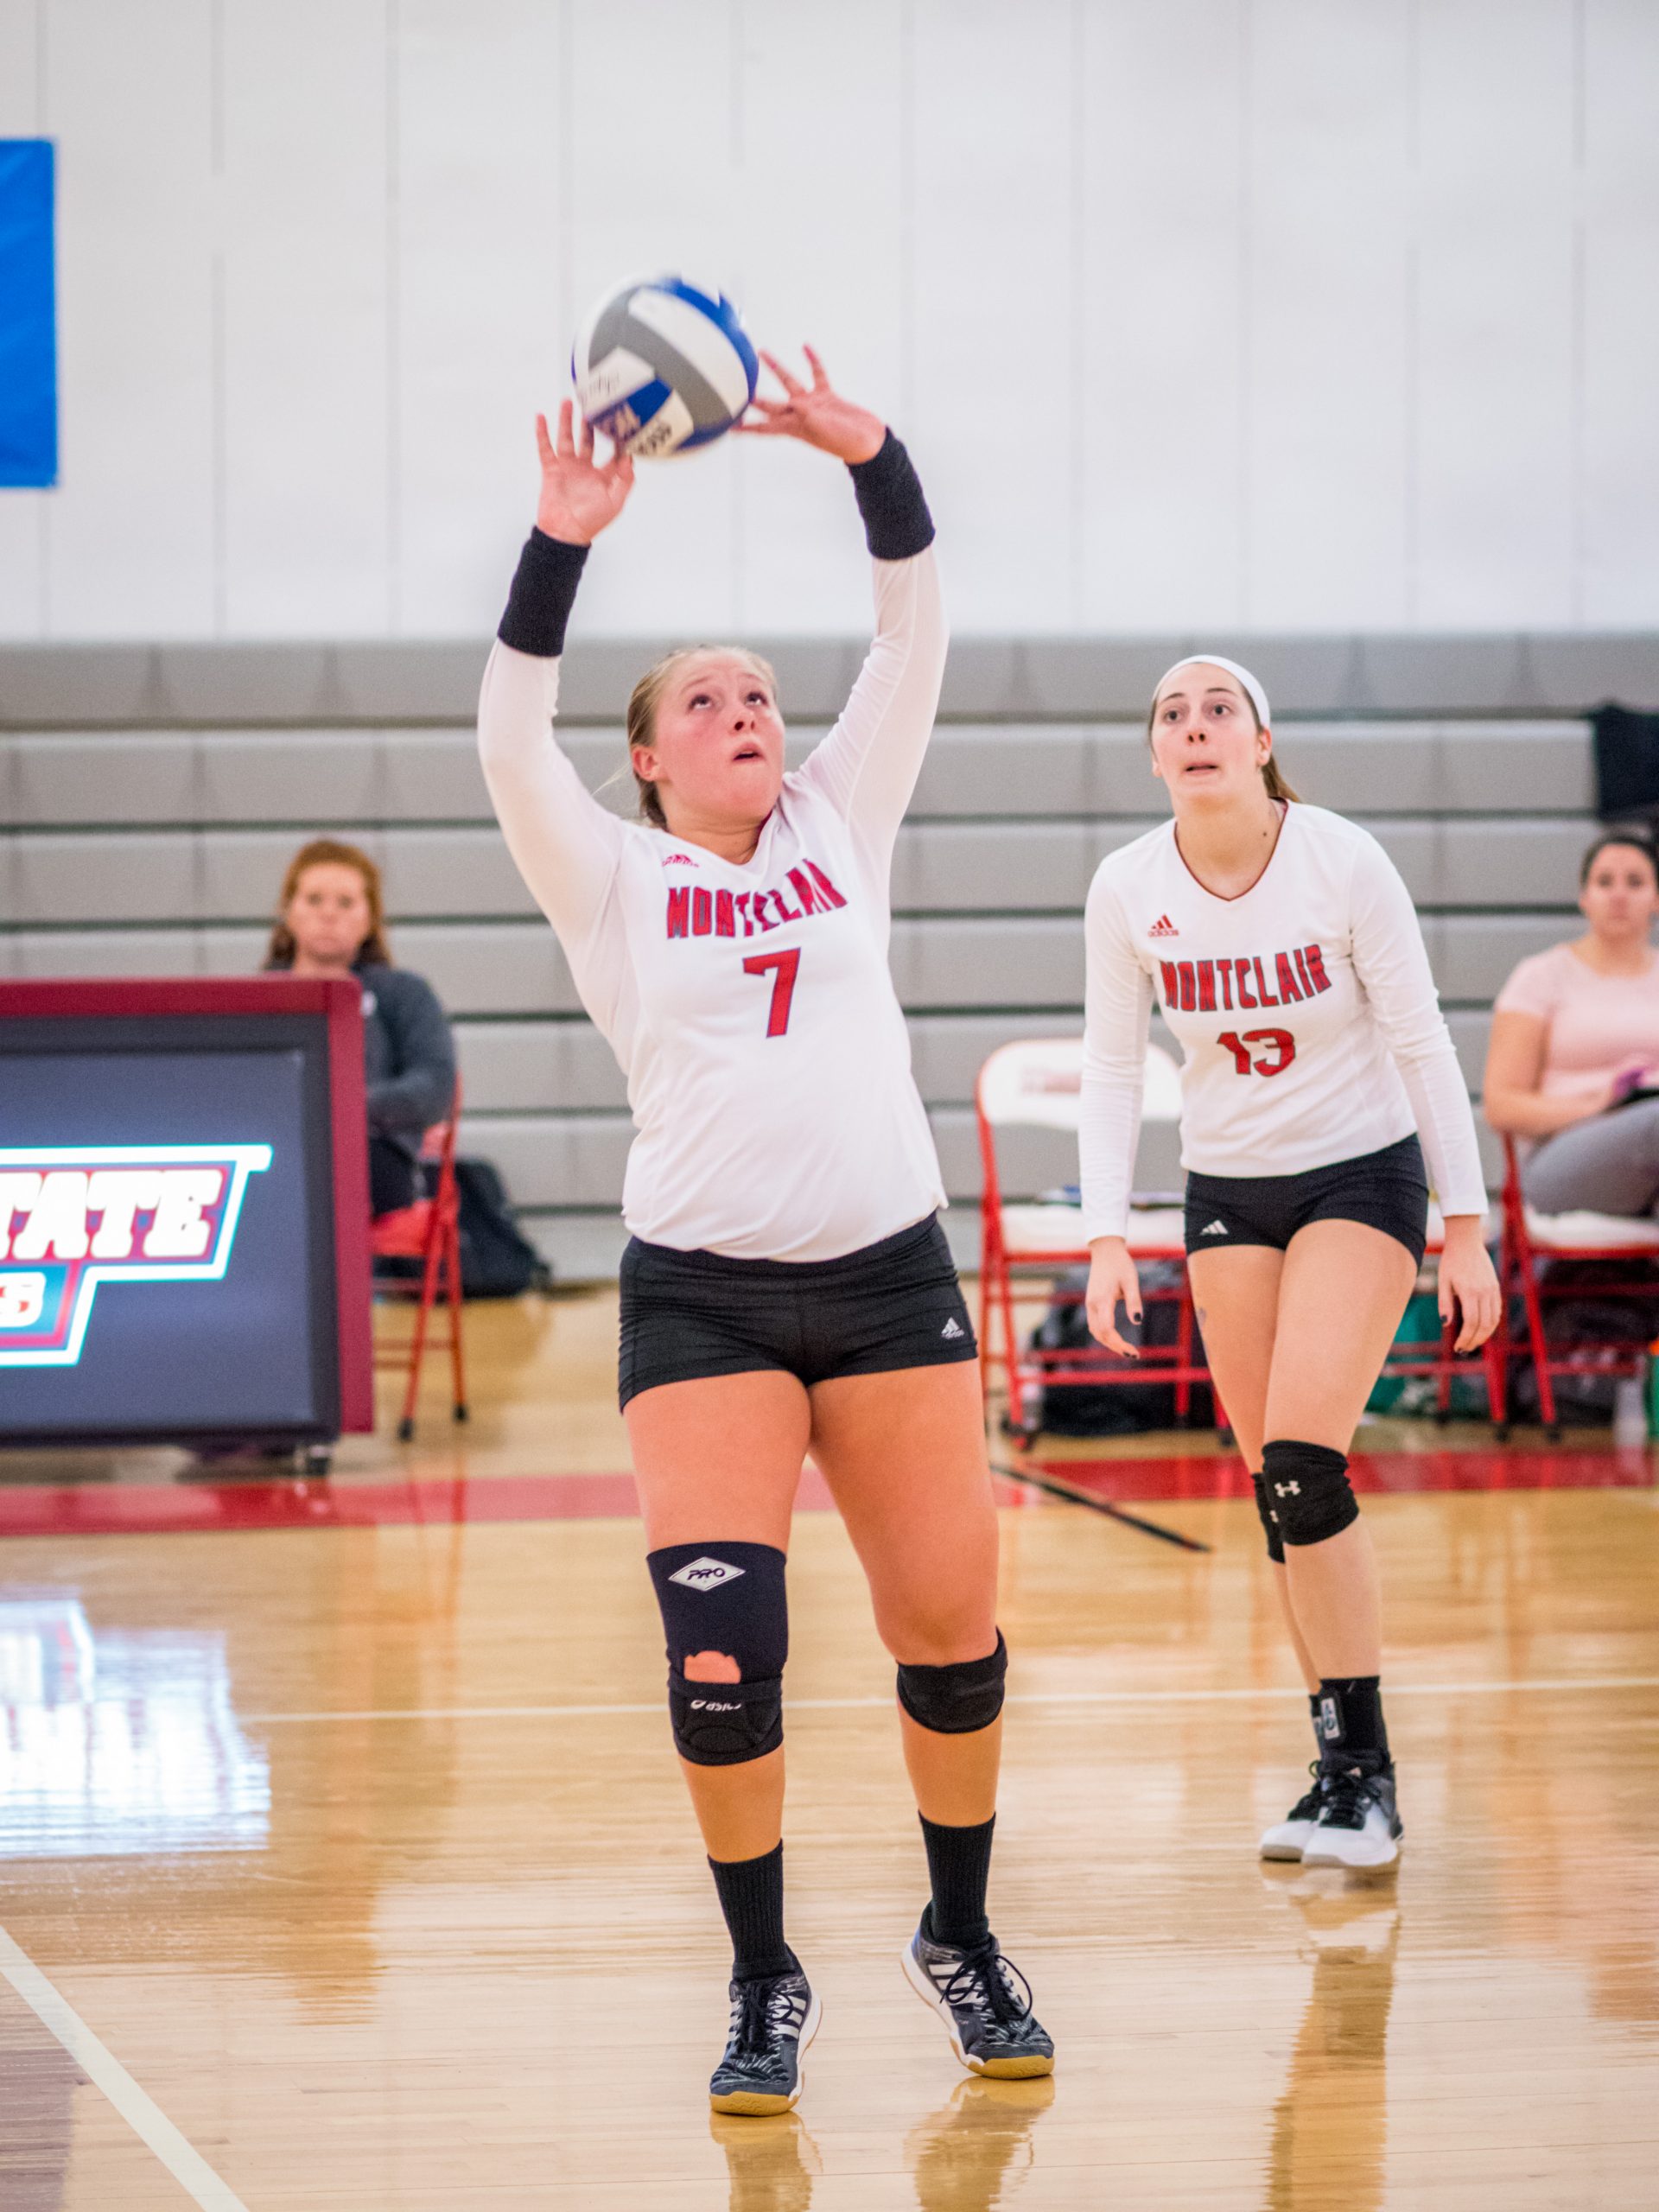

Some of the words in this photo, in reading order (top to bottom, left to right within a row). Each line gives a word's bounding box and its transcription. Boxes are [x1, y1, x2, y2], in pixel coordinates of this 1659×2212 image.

[741, 946, 801, 1039] 7
[1160, 944, 1332, 1012] MONTCLAIR
[1216, 1027, 1296, 1077] 13
[687, 1567, 726, 1580] PRO
